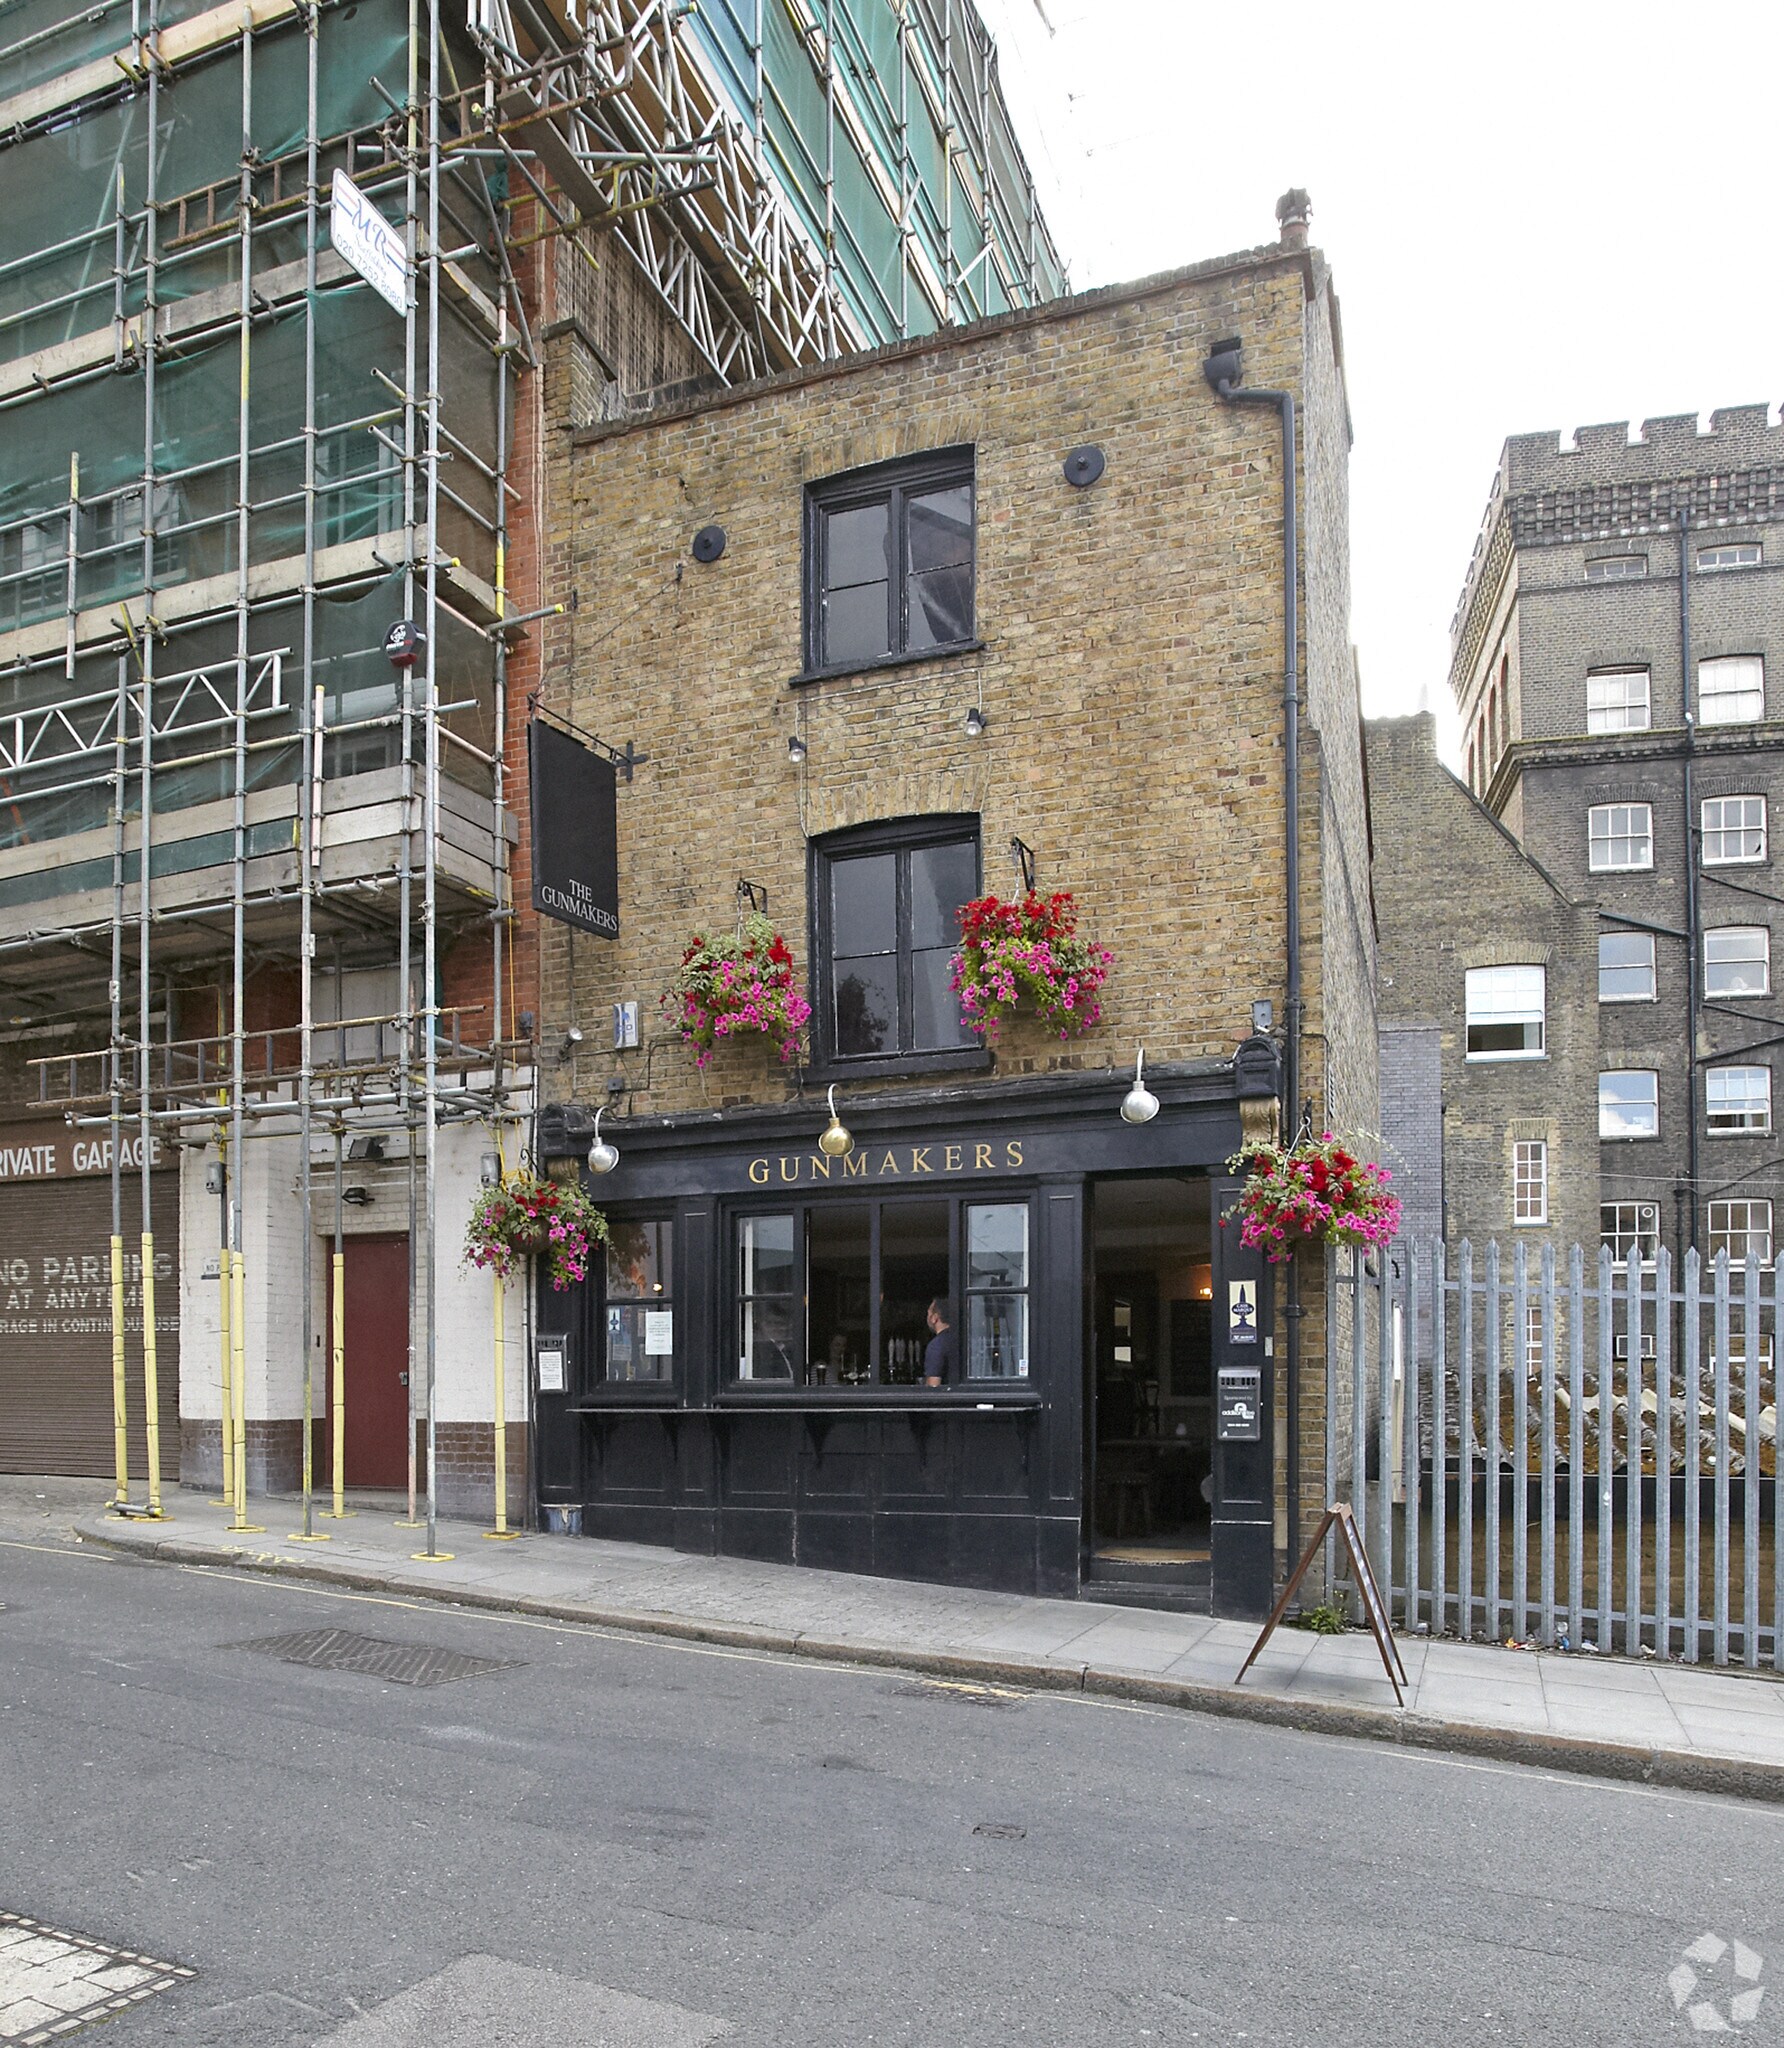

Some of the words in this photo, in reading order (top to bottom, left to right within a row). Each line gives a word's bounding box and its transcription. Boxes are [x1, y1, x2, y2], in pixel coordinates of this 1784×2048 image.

[336, 233, 354, 258] 020
[569, 879, 592, 903] THE
[542, 886, 617, 932] GUNMAKERS
[72, 1136, 161, 1172] GARAGE
[748, 1140, 1024, 1184] GUNMAKERS
[6, 1289, 34, 1309] AT
[43, 1319, 57, 1332] IN
[62, 1316, 144, 1332] CONTINOU
